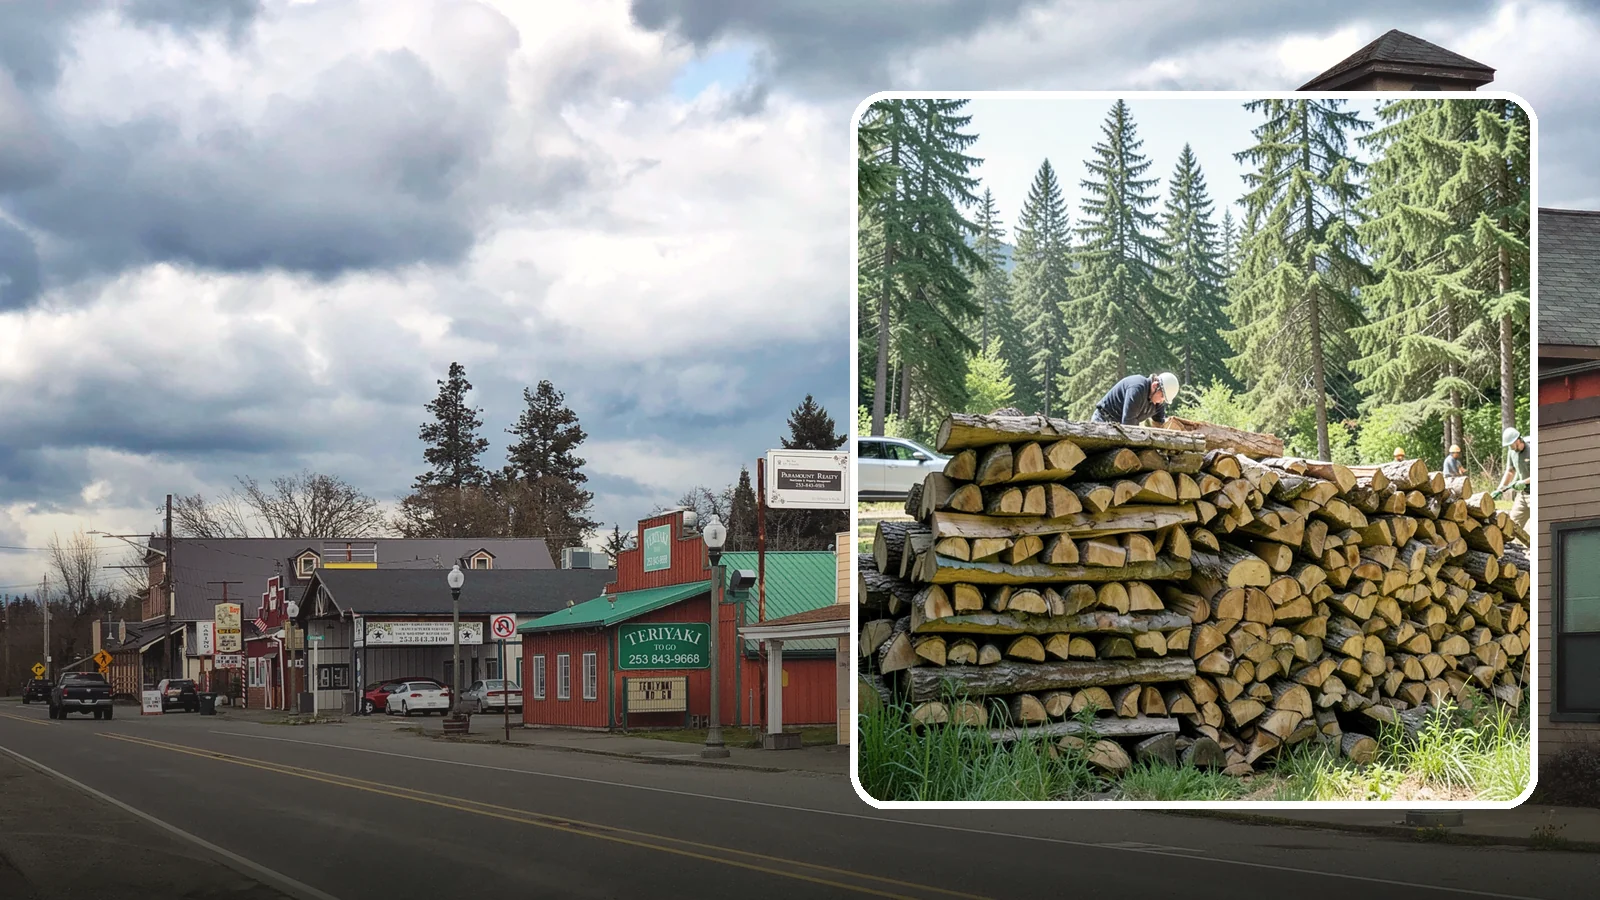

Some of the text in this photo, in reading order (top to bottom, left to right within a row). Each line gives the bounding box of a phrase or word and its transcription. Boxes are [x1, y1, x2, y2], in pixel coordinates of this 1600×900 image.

[781, 471, 839, 480] PARAMOUNT REALTY
[624, 627, 702, 646] TERIYAKI
[628, 653, 700, 665] 253 843-9668
